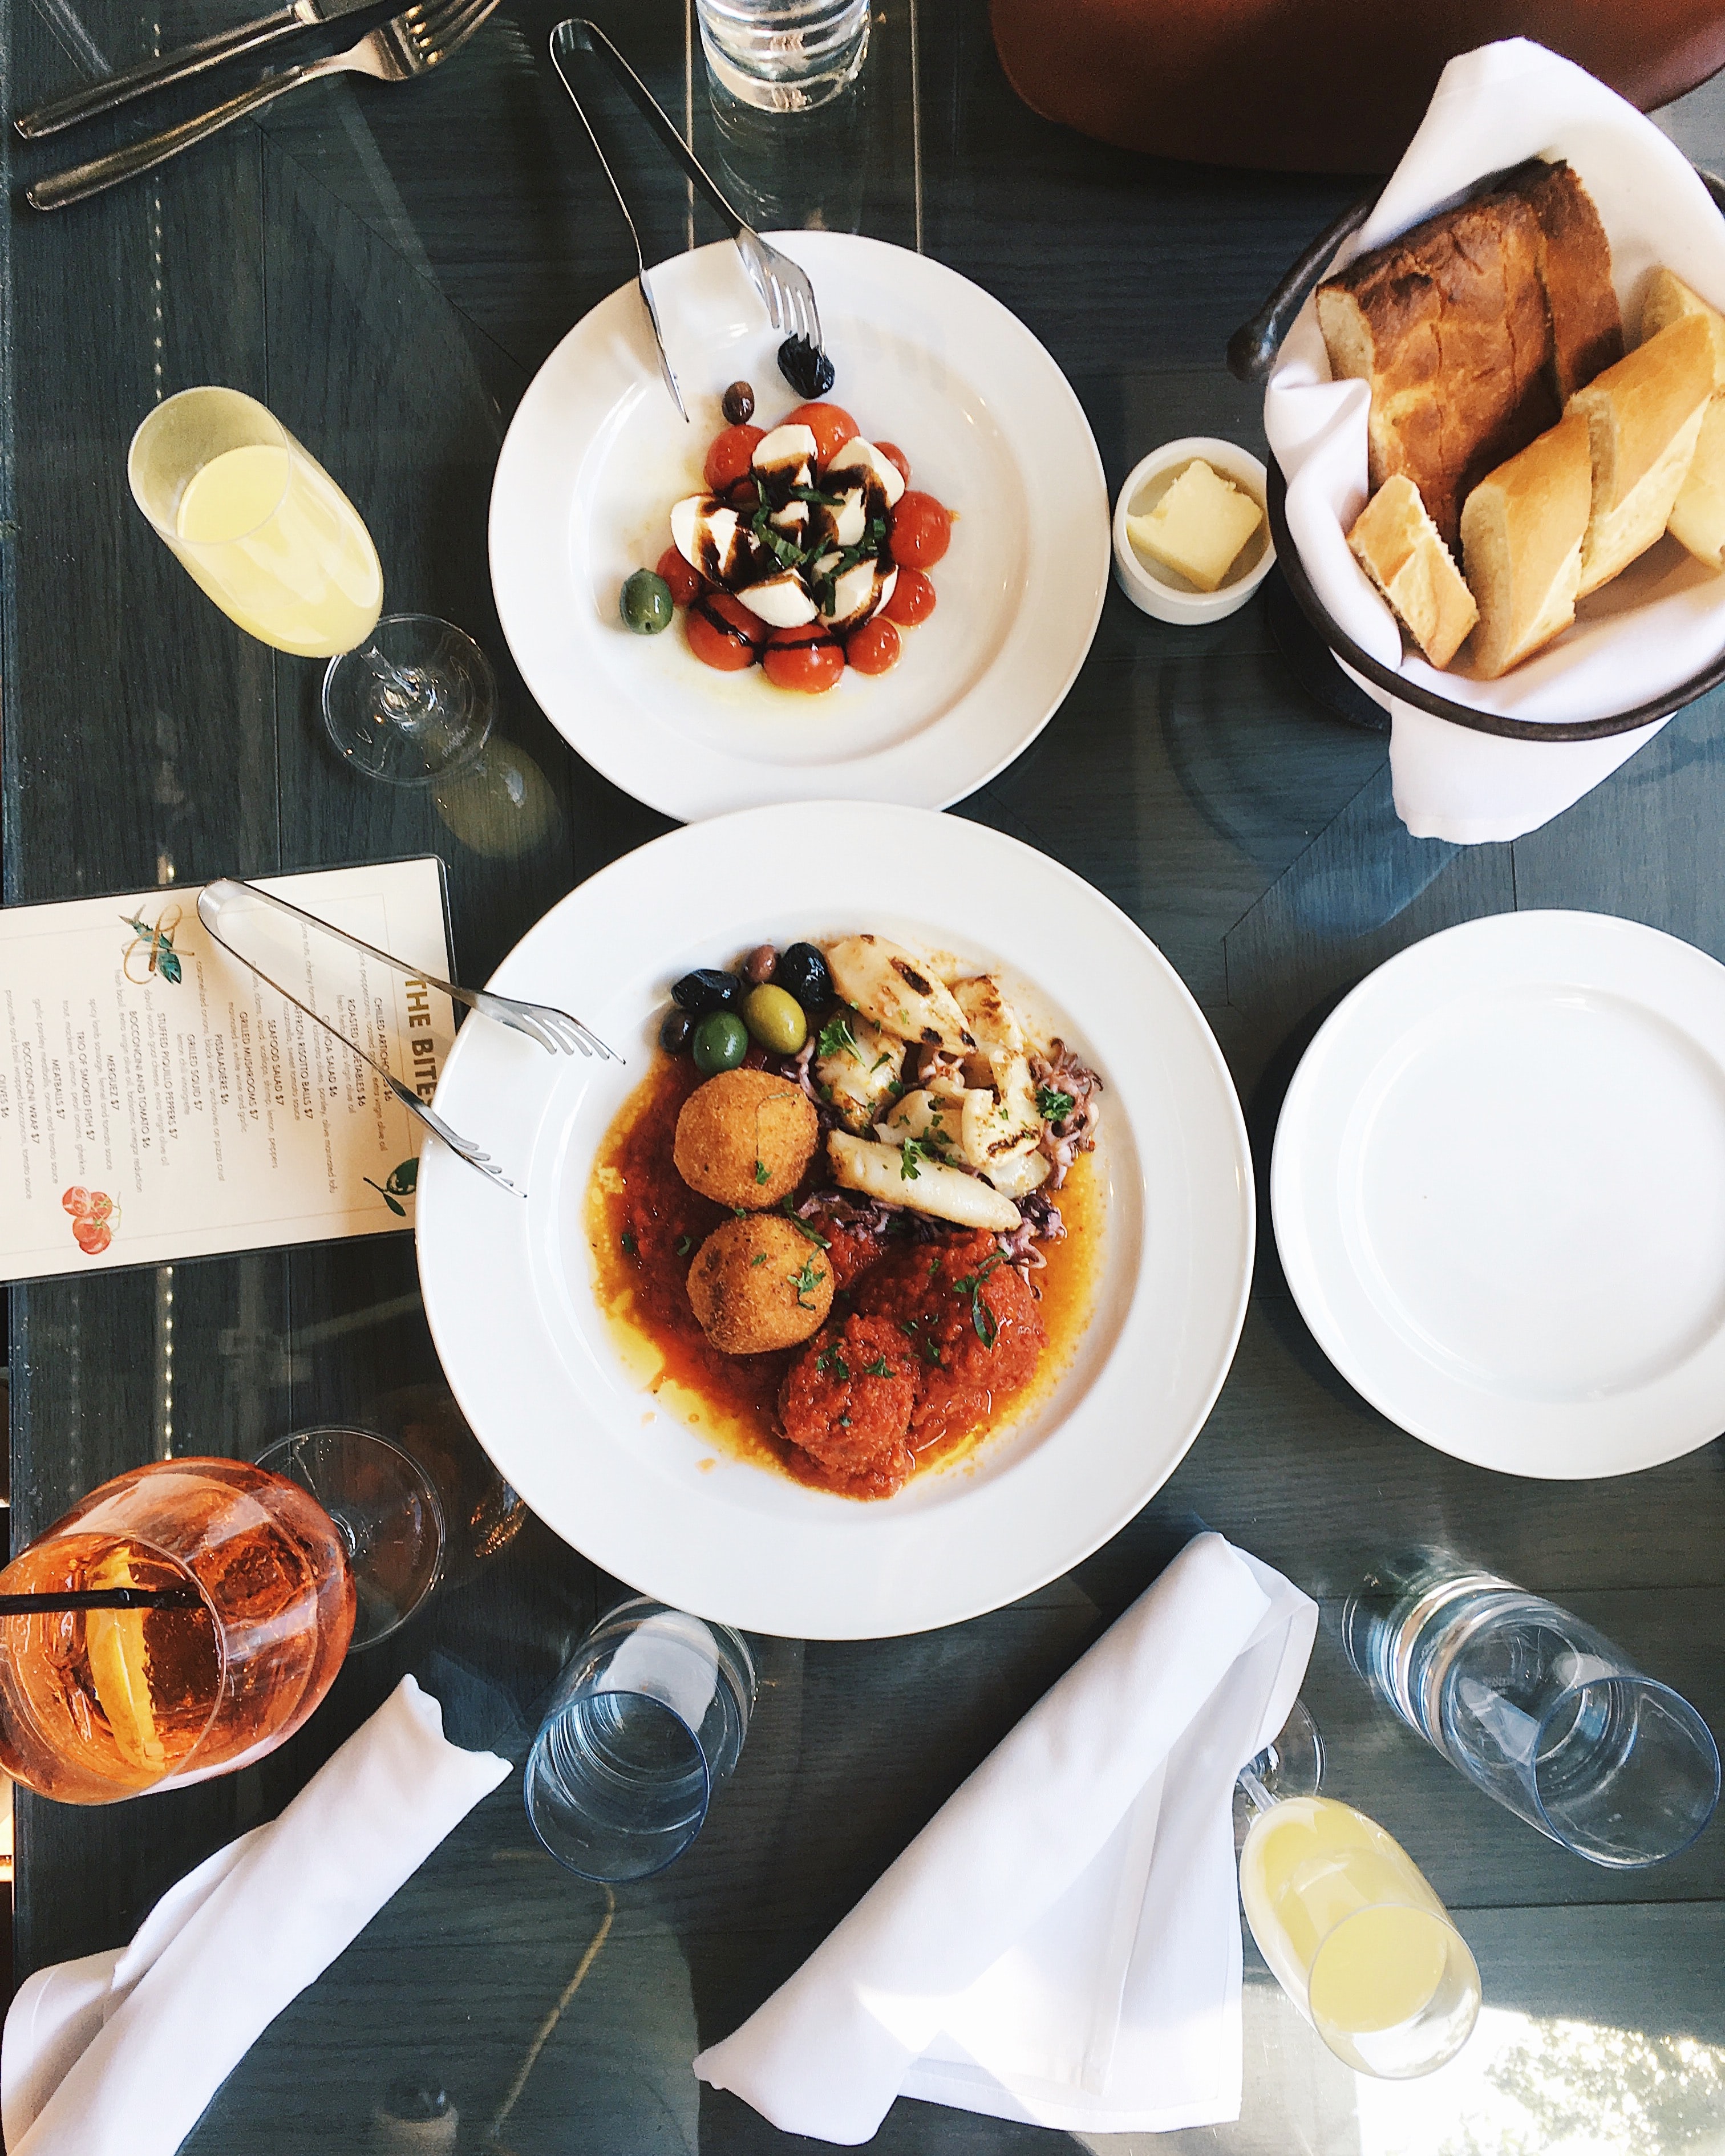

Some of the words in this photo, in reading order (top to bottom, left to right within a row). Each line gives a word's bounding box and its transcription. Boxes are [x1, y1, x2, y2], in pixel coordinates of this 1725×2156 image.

[114, 968, 124, 987] fresh
[305, 959, 314, 984] cherry
[196, 960, 208, 1007] caramelized
[32, 998, 43, 1020] garlic
[87, 998, 98, 1019] spicy
[144, 988, 153, 1011] david
[336, 994, 346, 1013] fresh
[404, 978, 431, 1028] THE
[91, 1020, 101, 1039] lamb
[118, 1012, 127, 1031] extra
[146, 1014, 156, 1039] woods
[156, 1012, 168, 1048] STUFFED
[228, 1001, 239, 1040] marinated
[239, 1011, 250, 1045] GRILLED
[254, 1019, 266, 1043] squid,
[282, 1000, 294, 1045] mozzarella,
[9, 1027, 18, 1043] and
[34, 1022, 46, 1049] parsley
[76, 1031, 86, 1051] TRIO
[119, 1034, 129, 1052] virgin
[129, 1010, 143, 1071] BOCCONCINI
[267, 1019, 280, 1062] SEAFOOD
[312, 1024, 322, 1059] kalamata
[366, 1020, 377, 1048] roasted
[11, 1044, 21, 1063] basil
[78, 1052, 87, 1065] OF
[94, 1041, 102, 1073] sausage,
[147, 1040, 157, 1058] goat
[187, 1034, 198, 1067] GRILLED
[204, 1038, 213, 1059] black
[287, 1047, 296, 1068] sweet
[347, 999, 359, 1039] ROASTED
[357, 1095, 366, 1107] $6
[374, 998, 385, 1031] CHILLED
[383, 1089, 392, 1101] $6
[22, 1041, 35, 1101] BOCCONCINI
[123, 1056, 131, 1073] olive
[160, 1050, 172, 1089] PIQUILLO
[233, 1051, 241, 1072] white
[259, 1045, 268, 1077] scallops,
[297, 1042, 309, 1079] RISOTTO
[326, 1055, 337, 1083] SALAD
[342, 1061, 351, 1081] virgin
[12, 1065, 25, 1100] wrapped
[51, 1058, 63, 1106] MEATBALLS
[106, 1054, 118, 1097] MERGUEZ
[124, 1076, 133, 1089] oil,
[135, 1073, 145, 1094] AND
[151, 1060, 160, 1089] cheese,
[191, 1069, 201, 1097] SQUID
[206, 1061, 214, 1085] olives,
[242, 1046, 257, 1107] MUSHROOMS
[272, 1064, 282, 1092] SALAD
[289, 1069, 298, 1096] tomato
[411, 1038, 438, 1108] BITE
[79, 1068, 91, 1106] SMOKED
[98, 1077, 107, 1100] fennel
[180, 1076, 191, 1116] vinaigrette
[301, 1081, 311, 1105] BALLS
[329, 1085, 338, 1097] $6
[345, 1083, 354, 1103] olive
[43, 1092, 52, 1113] onion
[69, 1092, 81, 1111] pearl
[100, 1102, 109, 1117] and
[110, 1099, 119, 1111] $7
[127, 1091, 136, 1124] balsamic
[164, 1091, 176, 1125] PEPPERS
[193, 1100, 203, 1112] $7
[209, 1087, 219, 1126] anchovies
[220, 1093, 229, 1105] $6
[237, 1093, 246, 1109] and
[274, 1094, 284, 1106] $7
[316, 1087, 328, 1116] parsley,
[347, 1104, 356, 1113] oil
[373, 1099, 383, 1120] virgin
[0, 1107, 9, 1118] $6
[28, 1104, 38, 1130] WRAP
[46, 1115, 55, 1131] and
[55, 1108, 65, 1120] $7
[83, 1108, 94, 1127] FISH
[137, 1096, 149, 1134] TOMATO
[155, 1113, 165, 1134] virgin
[237, 1111, 248, 1133] garlic
[249, 1109, 258, 1120] $7
[303, 1107, 313, 1120] $7
[30, 1133, 40, 1144] $7
[86, 1129, 95, 1141] $7
[102, 1119, 111, 1145] tomato
[168, 1128, 177, 1140] $7
[213, 1128, 220, 1138] on
[322, 1118, 330, 1137] olive
[376, 1121, 385, 1140] olive
[48, 1133, 57, 1159] tomato
[129, 1127, 139, 1155] vinegar
[141, 1137, 151, 1148] $6
[159, 1136, 167, 1154] olive
[212, 1140, 222, 1162] pizza
[379, 1141, 387, 1152] oil
[22, 1148, 31, 1175] tomato
[74, 1143, 86, 1175] gherkins
[161, 1156, 169, 1166] oil
[266, 1137, 277, 1169] peppers
[324, 1139, 335, 1177] marinated
[133, 1158, 143, 1193] reduction
[217, 1164, 225, 1182] crust
[328, 1179, 337, 1194] tofu
